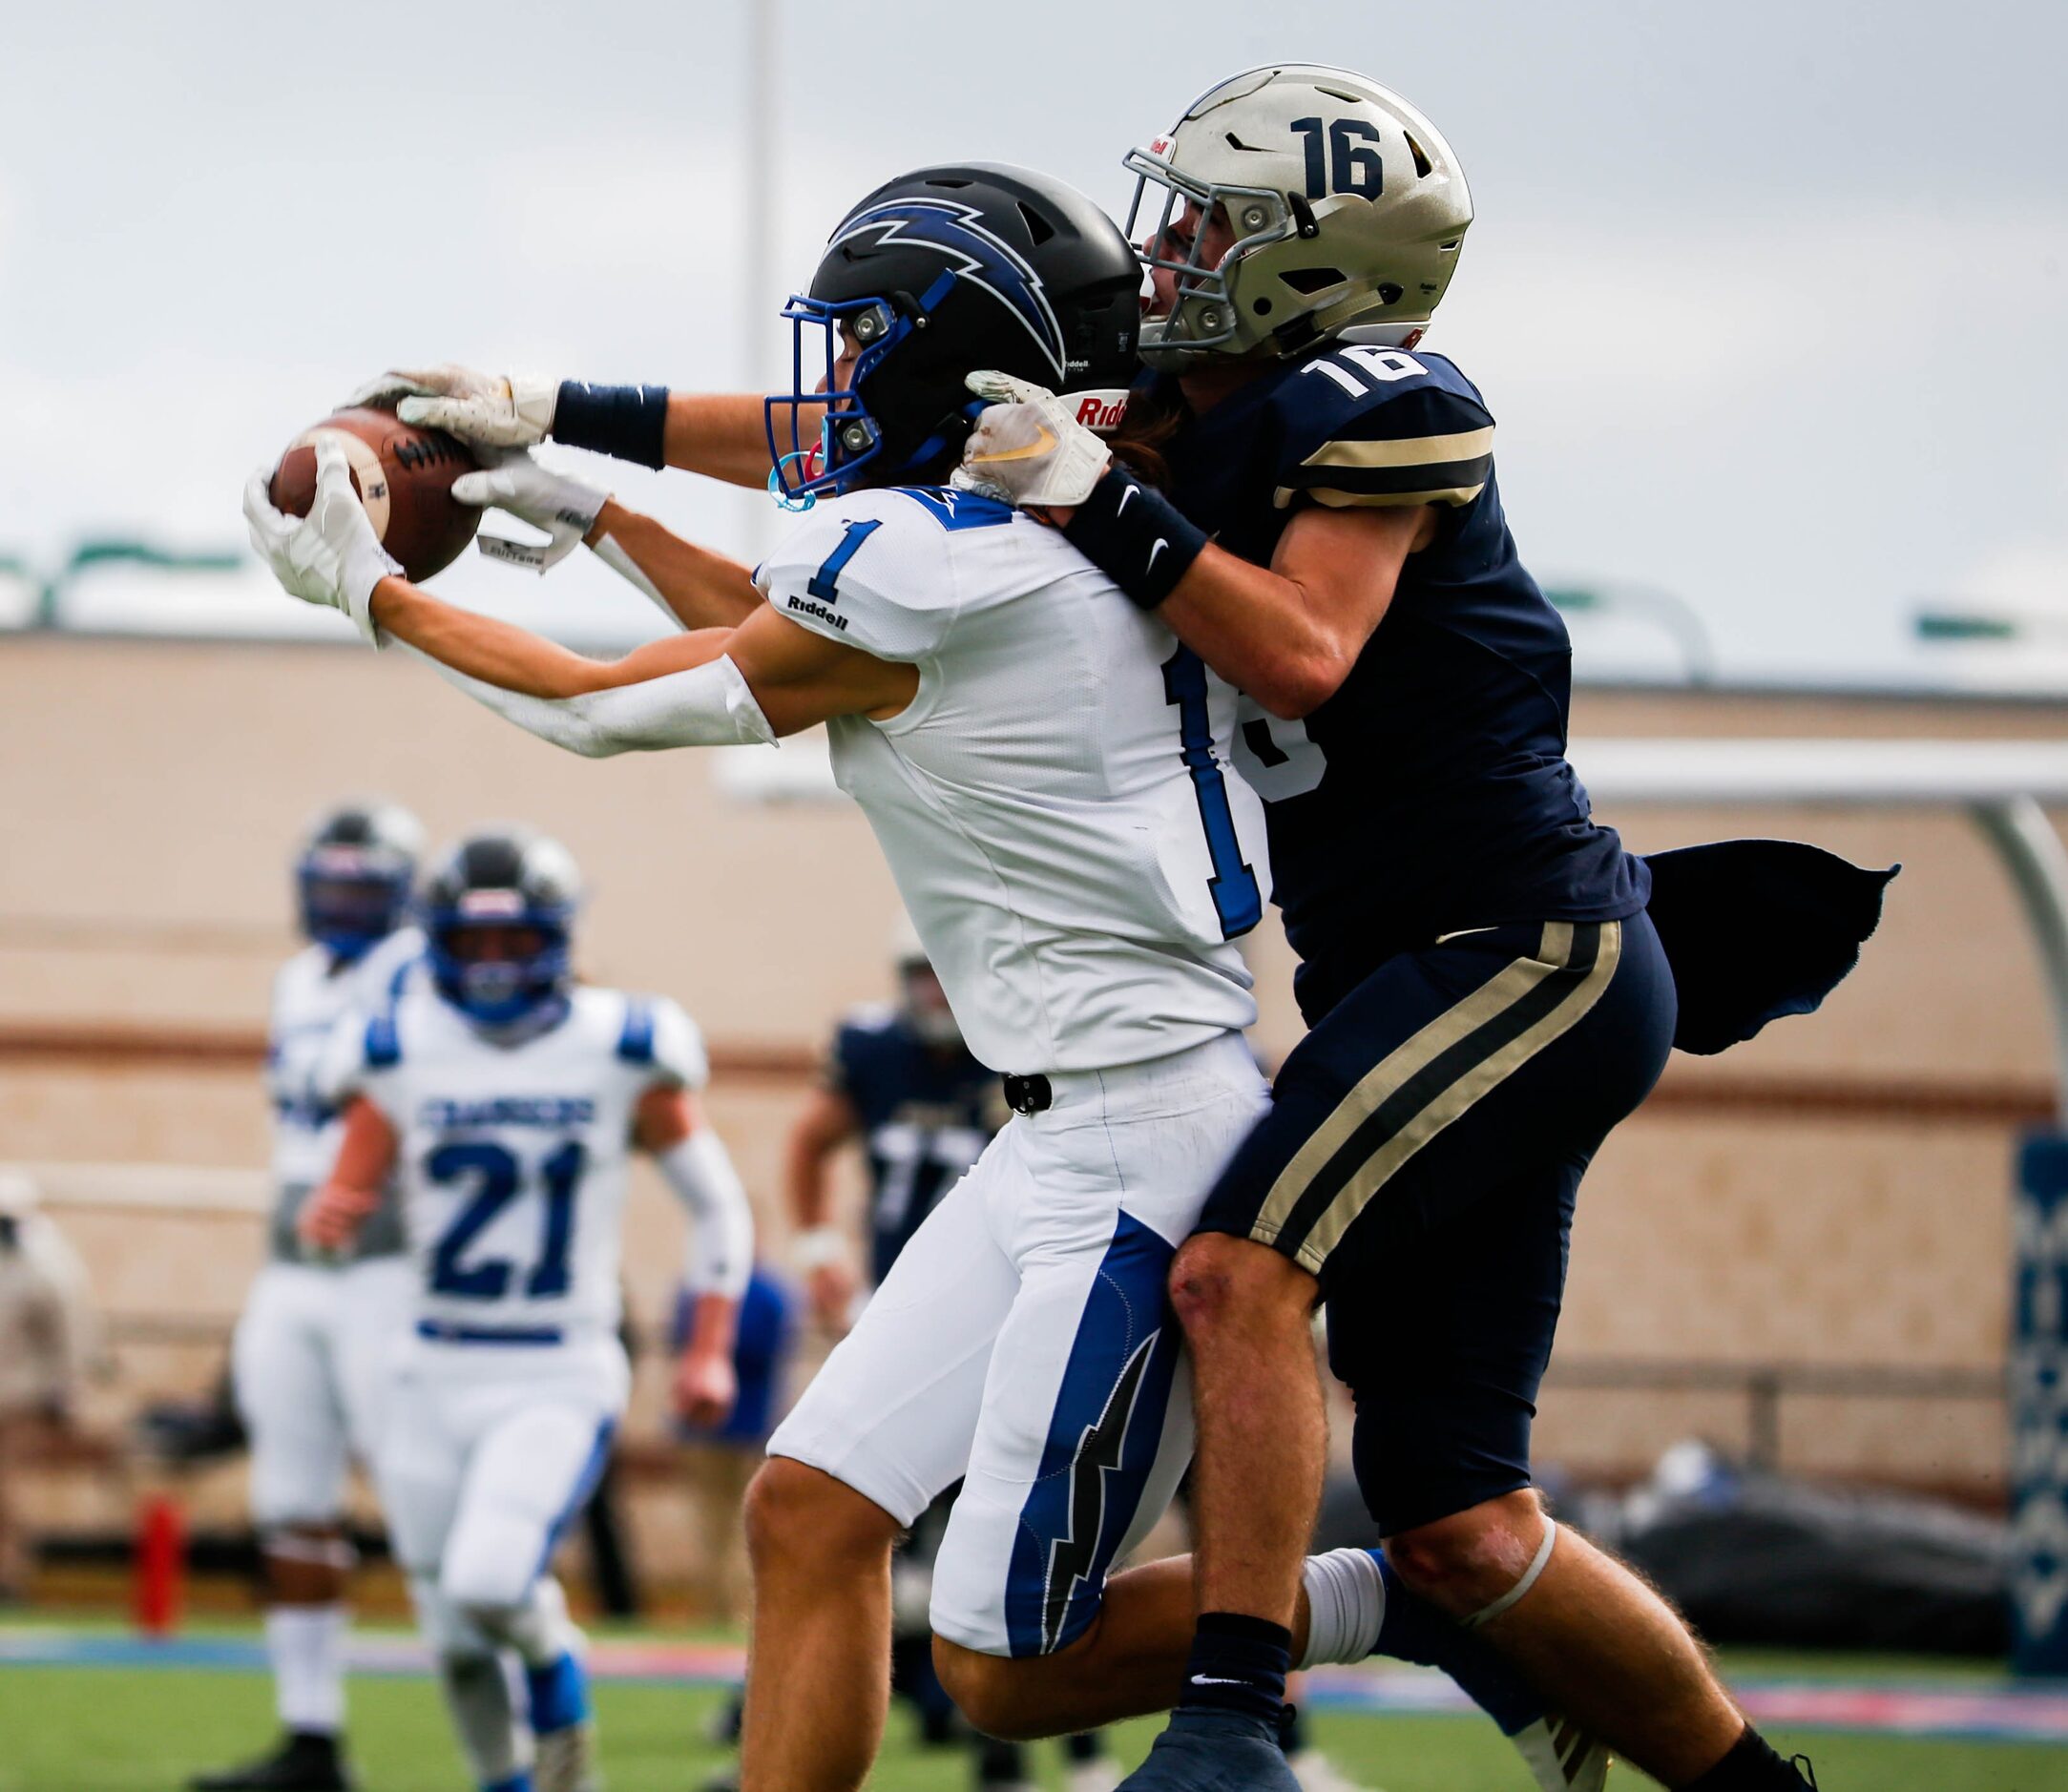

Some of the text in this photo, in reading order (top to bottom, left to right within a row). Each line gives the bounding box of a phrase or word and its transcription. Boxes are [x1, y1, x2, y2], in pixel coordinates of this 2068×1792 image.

[1290, 116, 1383, 201] 16
[1301, 344, 1429, 398] 16
[807, 518, 884, 605] 1
[787, 594, 848, 632] Riddell
[1160, 637, 1263, 942] 1
[423, 1140, 586, 1301] 21
